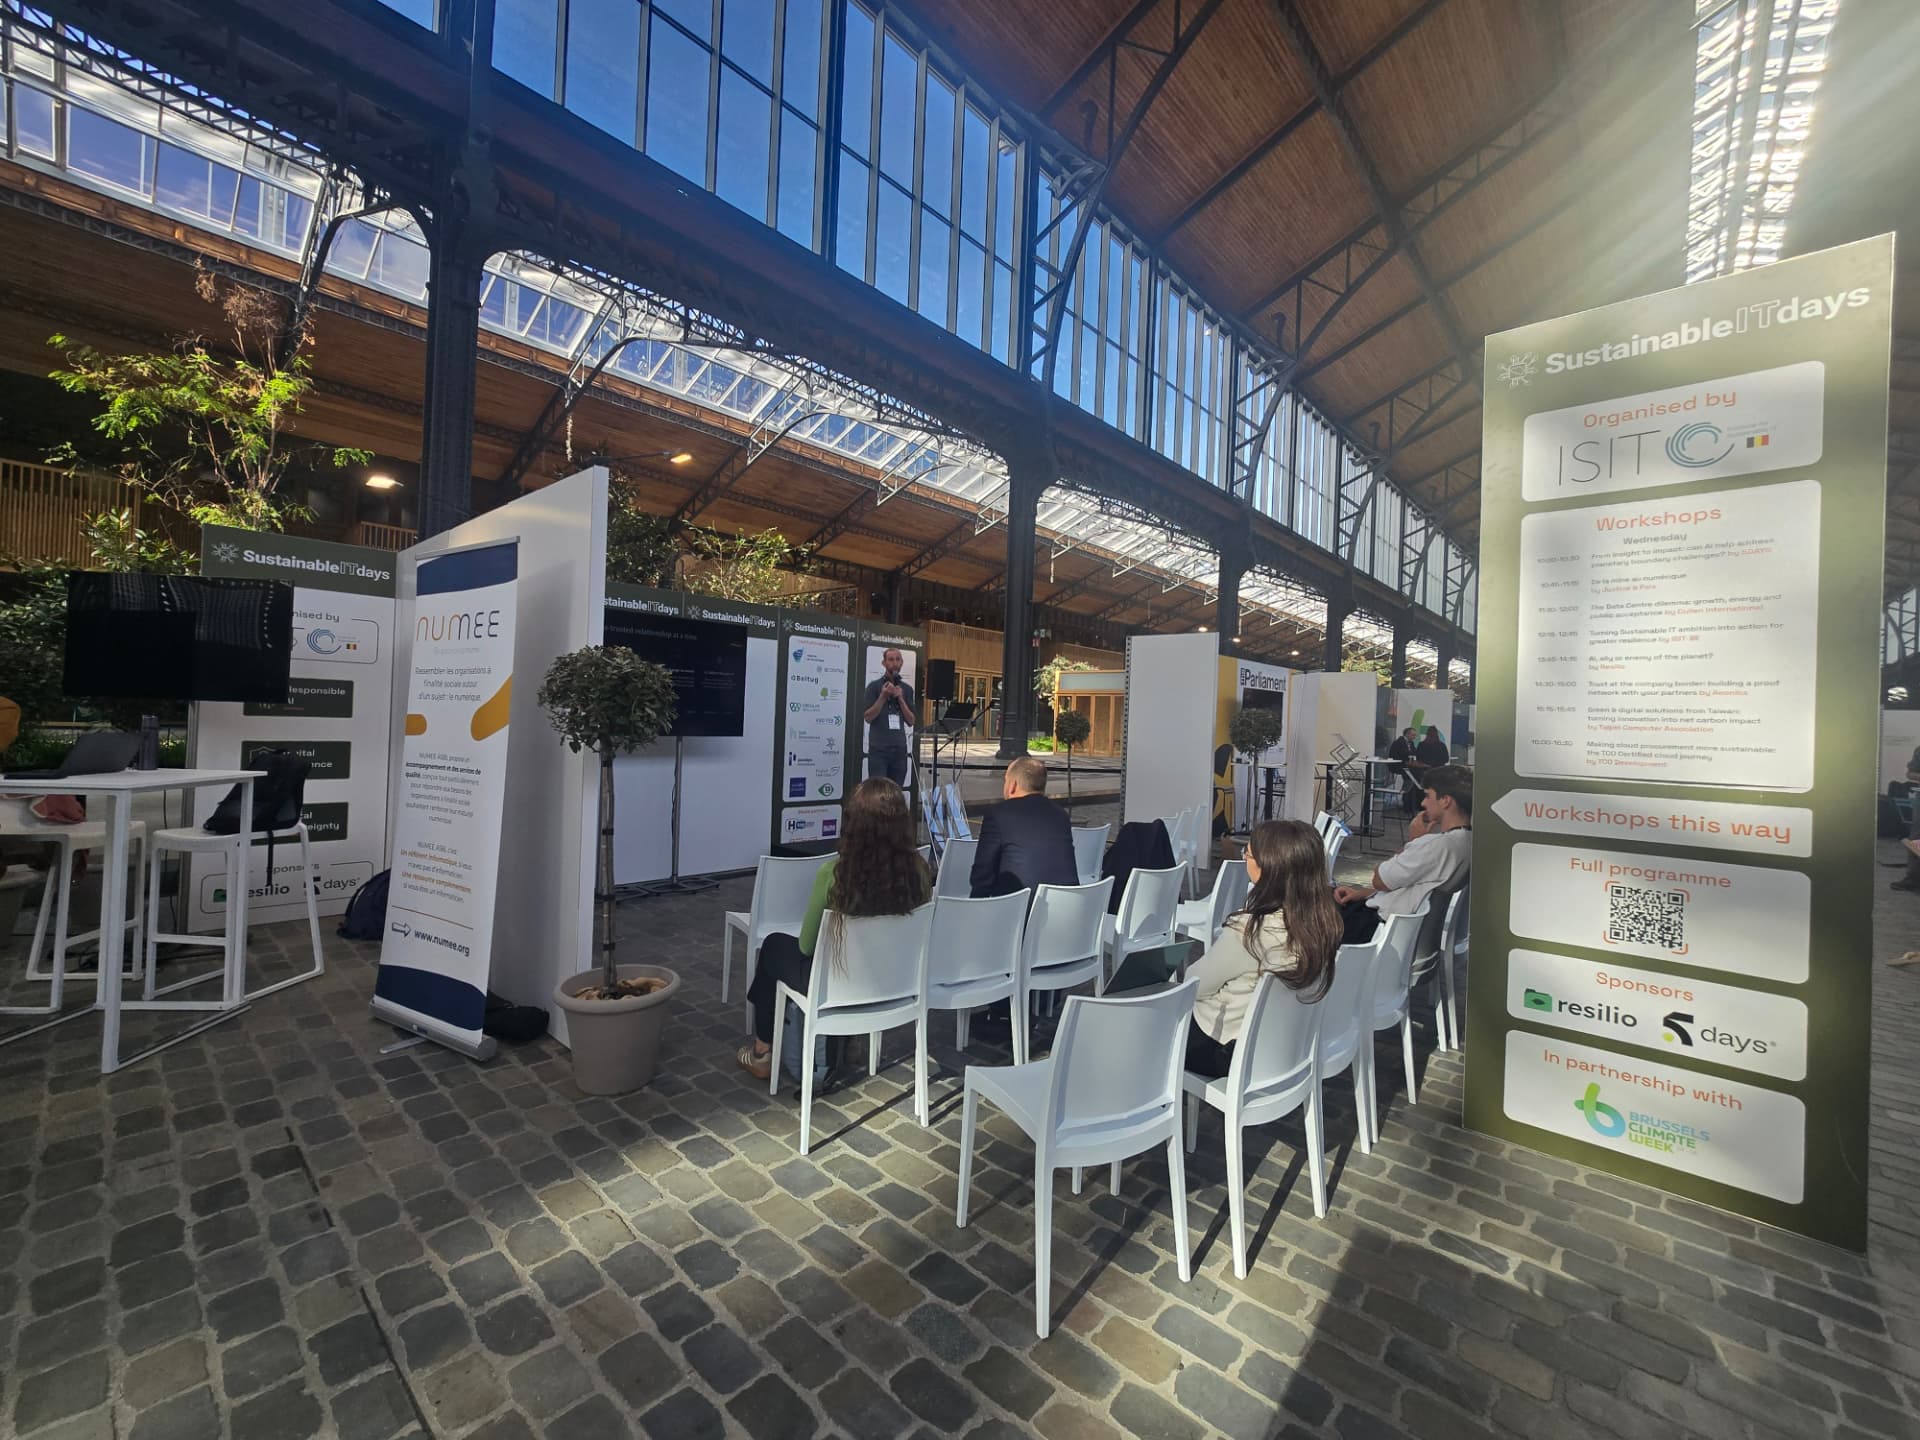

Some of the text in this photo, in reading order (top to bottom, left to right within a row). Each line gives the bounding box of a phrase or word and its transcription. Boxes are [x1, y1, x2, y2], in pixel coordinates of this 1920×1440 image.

[1584, 390, 1737, 429] Organised by
[1596, 507, 1722, 531] Workshops
[1623, 533, 1688, 545] Wednesday
[325, 613, 341, 623] by
[603, 597, 679, 615] stainableITdays
[1245, 669, 1287, 690] Parliament
[1523, 802, 1791, 845] Workshops this way
[1570, 857, 1732, 889] Full programme
[413, 929, 471, 957] www.numee.org
[1596, 971, 1694, 1001] Sponsors
[1558, 998, 1638, 1027] resilio
[1544, 1049, 1743, 1112] In partnership with
[1628, 1121, 1697, 1149] CLIMATE
[1629, 1110, 1711, 1142] BRUSSELS
[1628, 1132, 1674, 1153] WEEK
